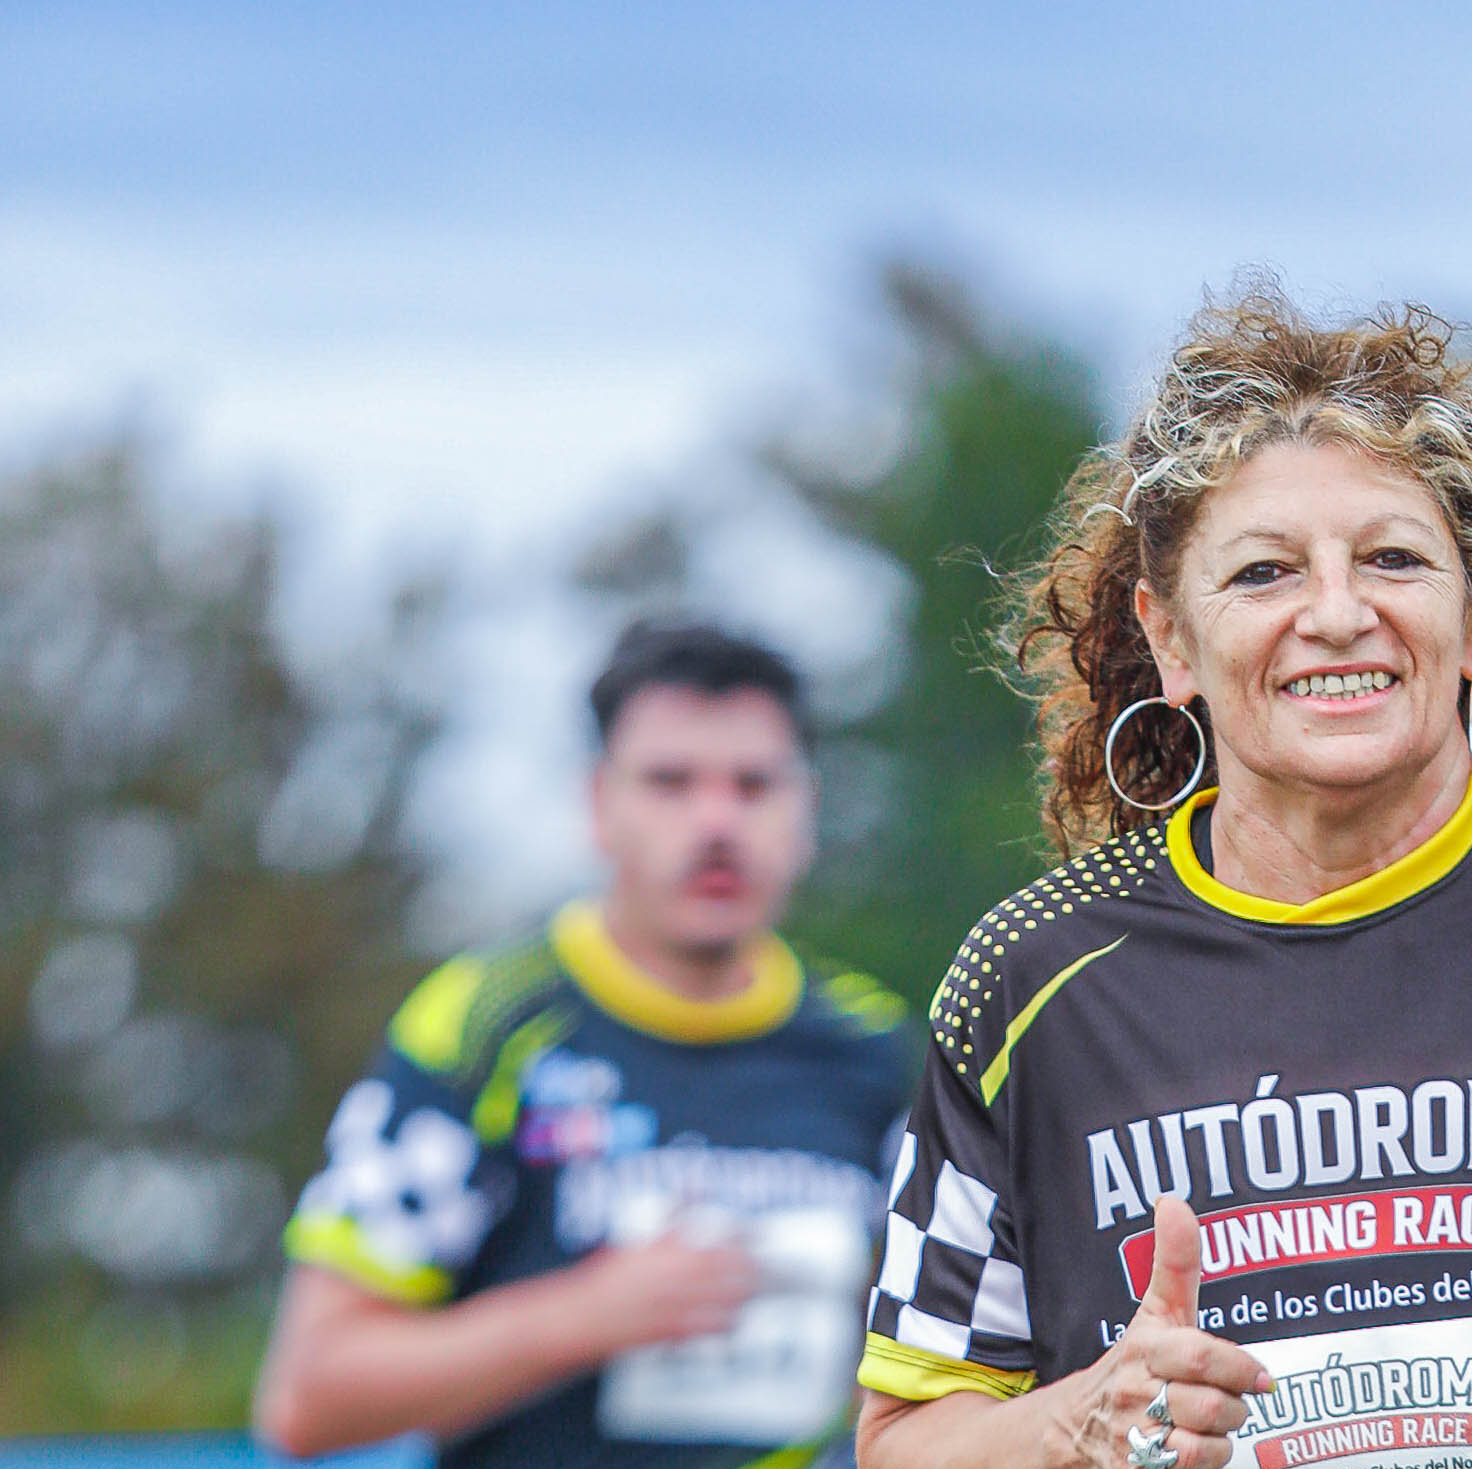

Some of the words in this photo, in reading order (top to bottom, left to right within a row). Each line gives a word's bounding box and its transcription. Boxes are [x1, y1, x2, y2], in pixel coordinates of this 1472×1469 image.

[1198, 1201, 1378, 1276] UNNING
[1230, 1295, 1268, 1325] de
[1274, 1290, 1319, 1320] los
[1323, 1279, 1427, 1314] Clubes
[1280, 1417, 1395, 1466] RUNNING
[1402, 1416, 1469, 1446] RACE
